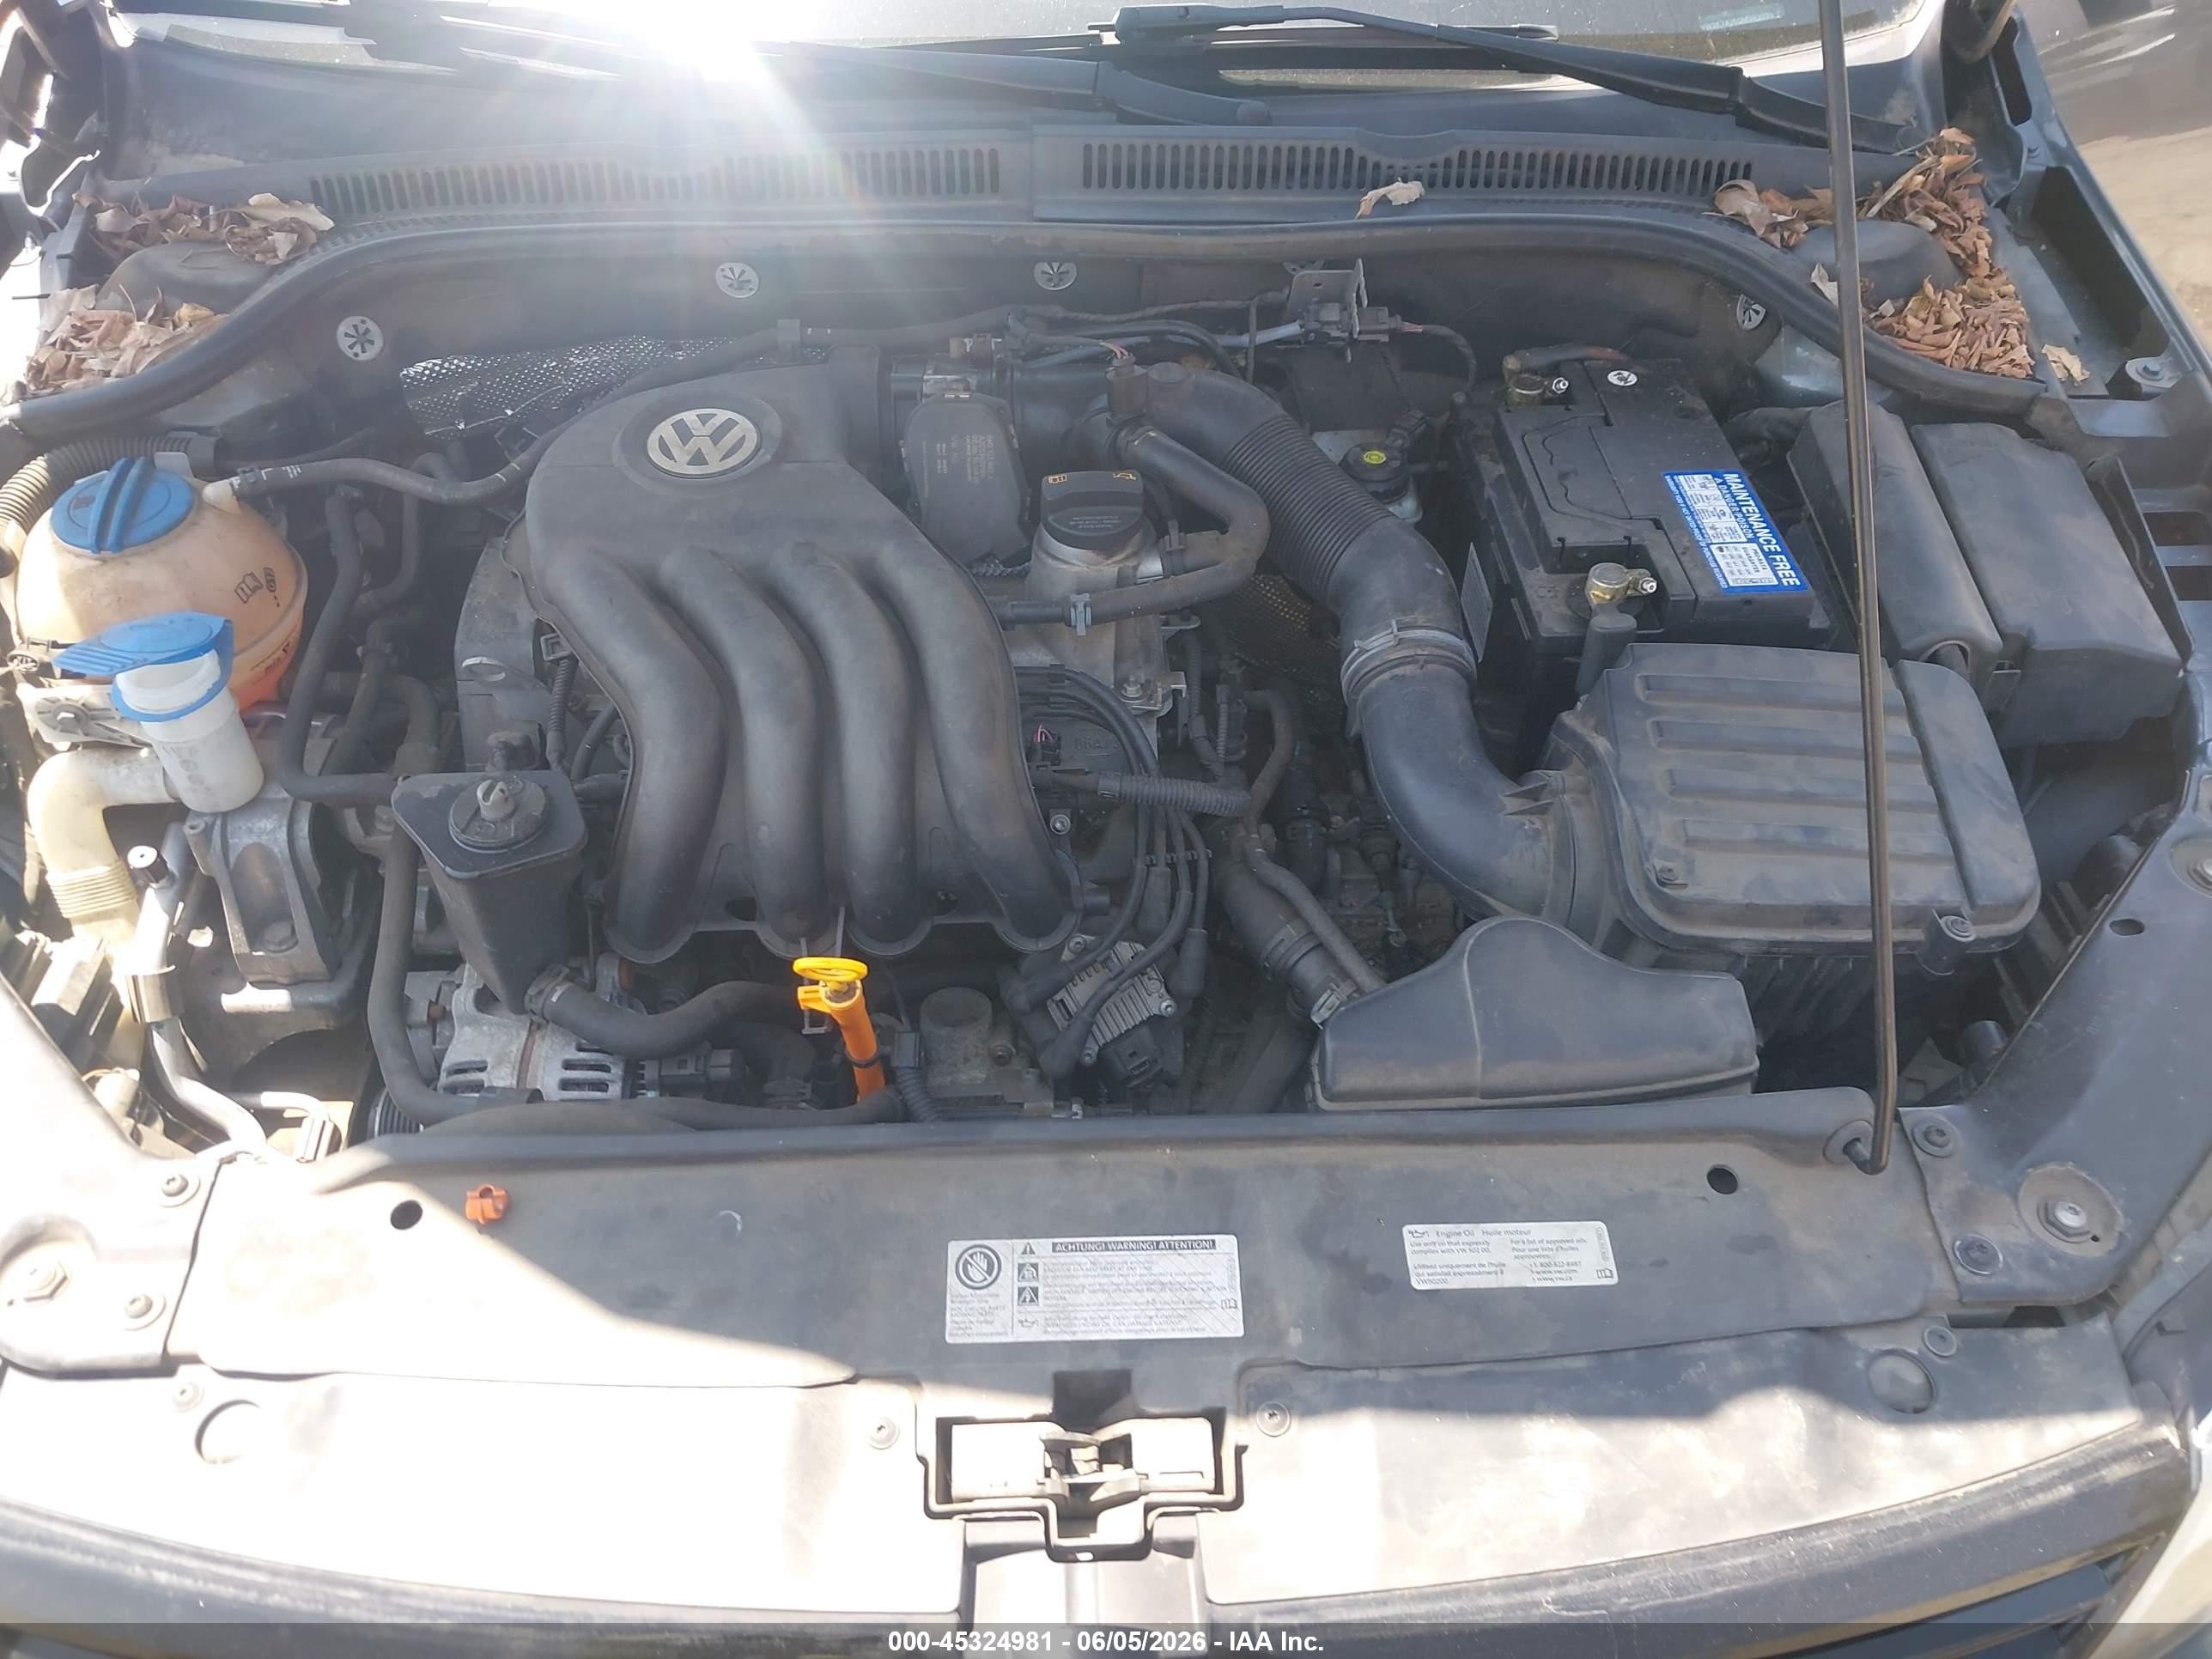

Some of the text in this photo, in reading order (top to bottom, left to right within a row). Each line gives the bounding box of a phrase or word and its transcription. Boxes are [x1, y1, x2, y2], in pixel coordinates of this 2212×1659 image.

[647, 408, 757, 475] VW
[1718, 484, 1755, 539] DANGER/POISON
[1723, 473, 1782, 553] MAINTENANCE
[1769, 555, 1801, 586] FREE
[1055, 1239, 1212, 1252] ACHTUNG! WARNING! ATTENTION!
[1436, 1229, 1462, 1238] Engine
